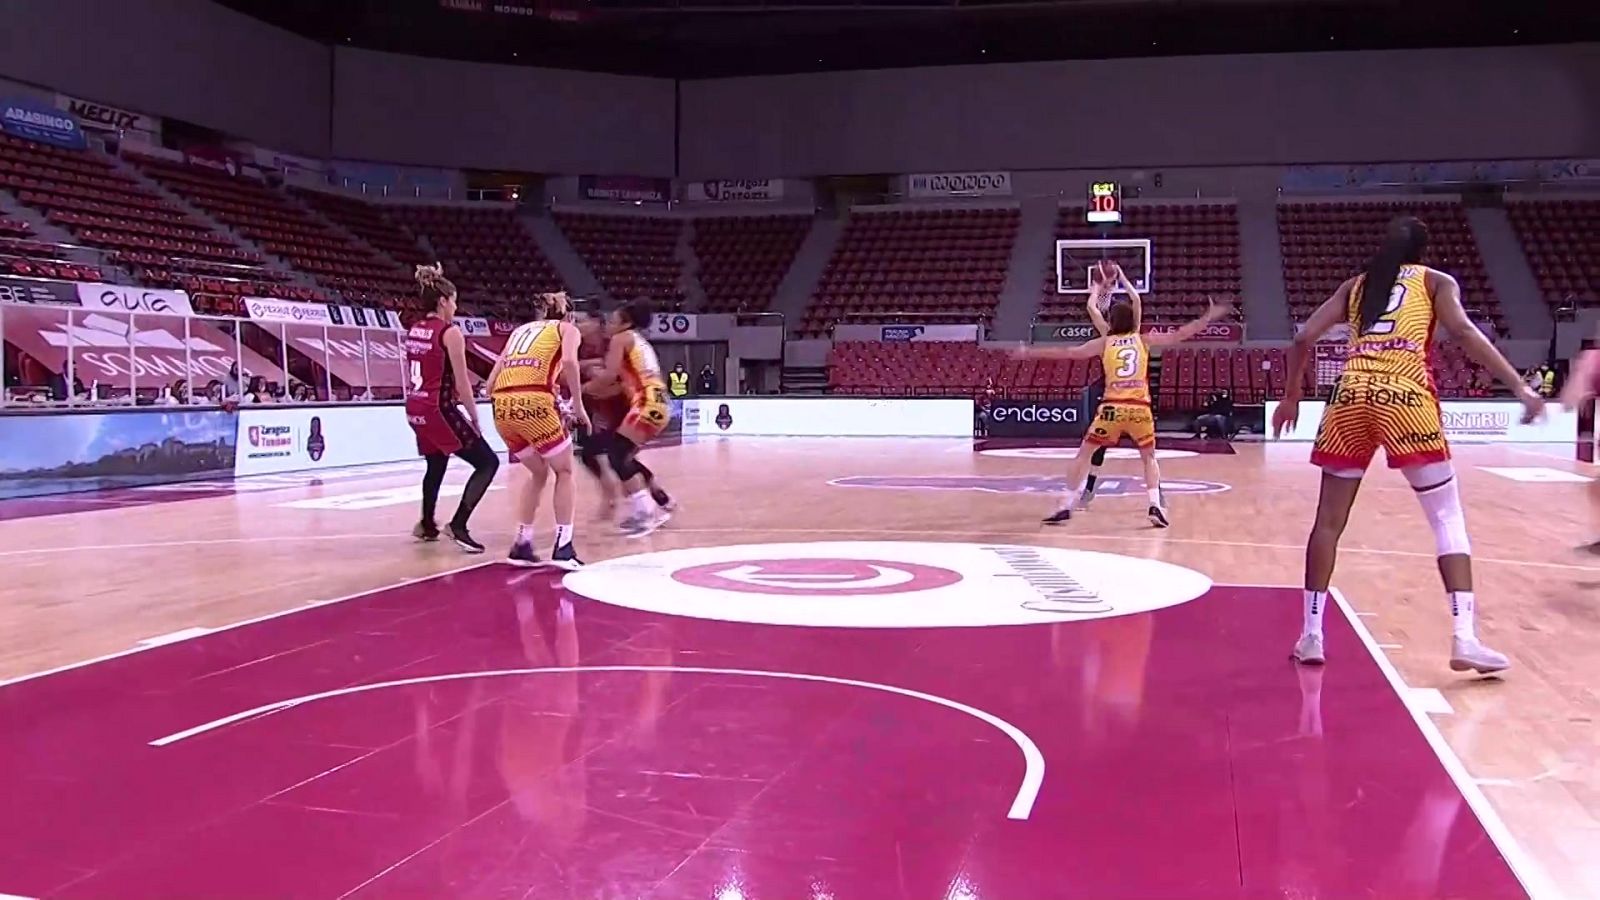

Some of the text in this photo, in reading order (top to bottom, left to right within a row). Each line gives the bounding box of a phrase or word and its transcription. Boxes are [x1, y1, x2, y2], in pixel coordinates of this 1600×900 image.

[930, 174, 1005, 191] MONDO
[1093, 195, 1115, 211] 10
[100, 290, 178, 313] aura
[1060, 327, 1093, 337] caser
[1115, 346, 1138, 379] 3
[993, 404, 1078, 422] endesa
[261, 424, 291, 436] Zaragoza
